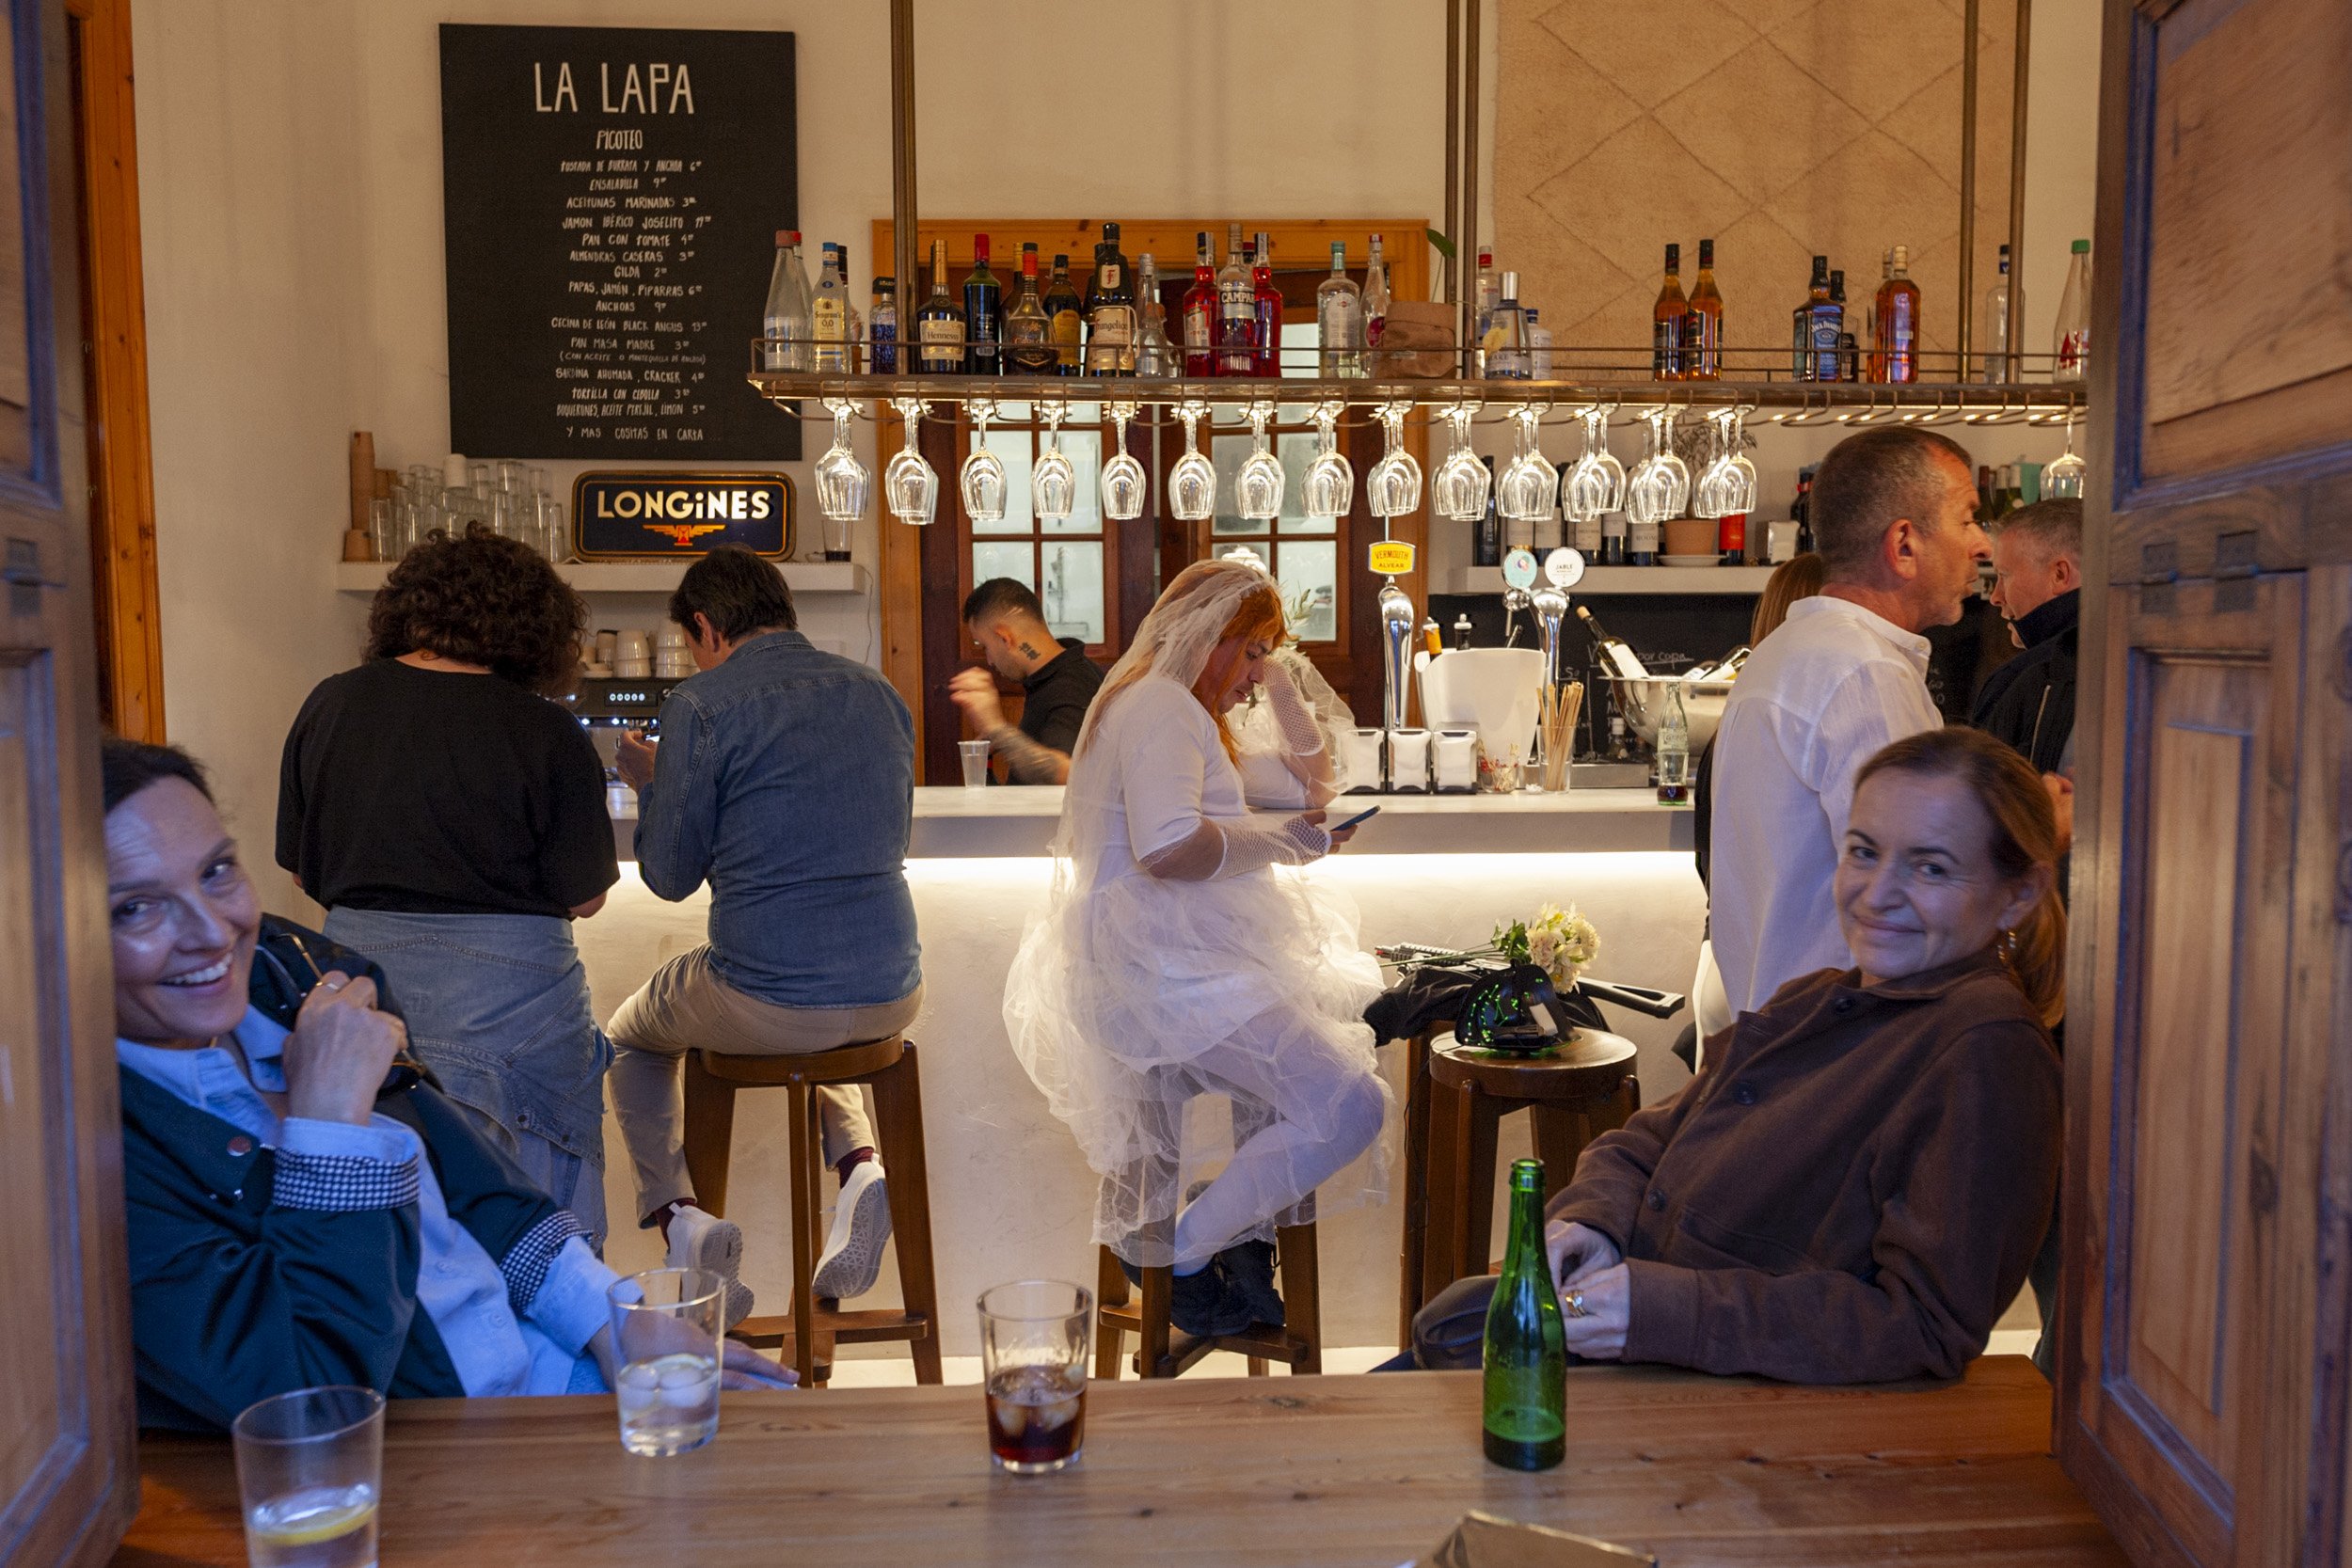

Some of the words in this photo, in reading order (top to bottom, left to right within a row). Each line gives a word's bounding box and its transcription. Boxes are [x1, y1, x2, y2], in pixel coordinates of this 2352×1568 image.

[534, 62, 578, 112] LA
[601, 63, 694, 114] LAPA
[596, 129, 644, 150] PICOTEO
[561, 161, 591, 172] TOSTADA
[596, 161, 605, 172] DE
[608, 160, 637, 172] BURRATA
[644, 161, 649, 172] Y
[656, 160, 682, 172] ANCHOA
[589, 177, 638, 191] ENSALADILLA
[566, 197, 615, 209] ACEITUNAS
[625, 197, 675, 209] MARINADAS
[642, 215, 683, 230] JOSELITO
[582, 233, 600, 246] PAN
[608, 234, 628, 245] CON
[637, 234, 671, 246] TOMATE
[570, 250, 615, 262] ALMENDRAS
[623, 251, 663, 262] CASERAS
[613, 265, 641, 278] GILDA
[638, 285, 684, 296] PIPARRAS
[596, 300, 635, 312] ANCHOAS
[551, 316, 580, 328] CECINA
[582, 319, 593, 328] DE
[596, 317, 616, 329] LEÓN
[623, 320, 649, 331] BLACK
[655, 322, 684, 332] ANGUS
[927, 331, 960, 341] Hennessy
[570, 337, 587, 348] PAN
[594, 338, 617, 349] MASA
[627, 339, 656, 350] MADRE
[644, 370, 681, 384] CRACKER
[572, 387, 608, 400] TORTILLA
[613, 388, 627, 400] CON
[632, 388, 660, 400] CEBOLLA
[601, 404, 622, 416] ACEITE
[566, 426, 573, 437] Y
[581, 427, 601, 437] MAS
[614, 427, 649, 439] COSITAS
[657, 428, 668, 439] EN
[677, 428, 704, 440] CARTA
[1375, 549, 1408, 561] VERMOUTH
